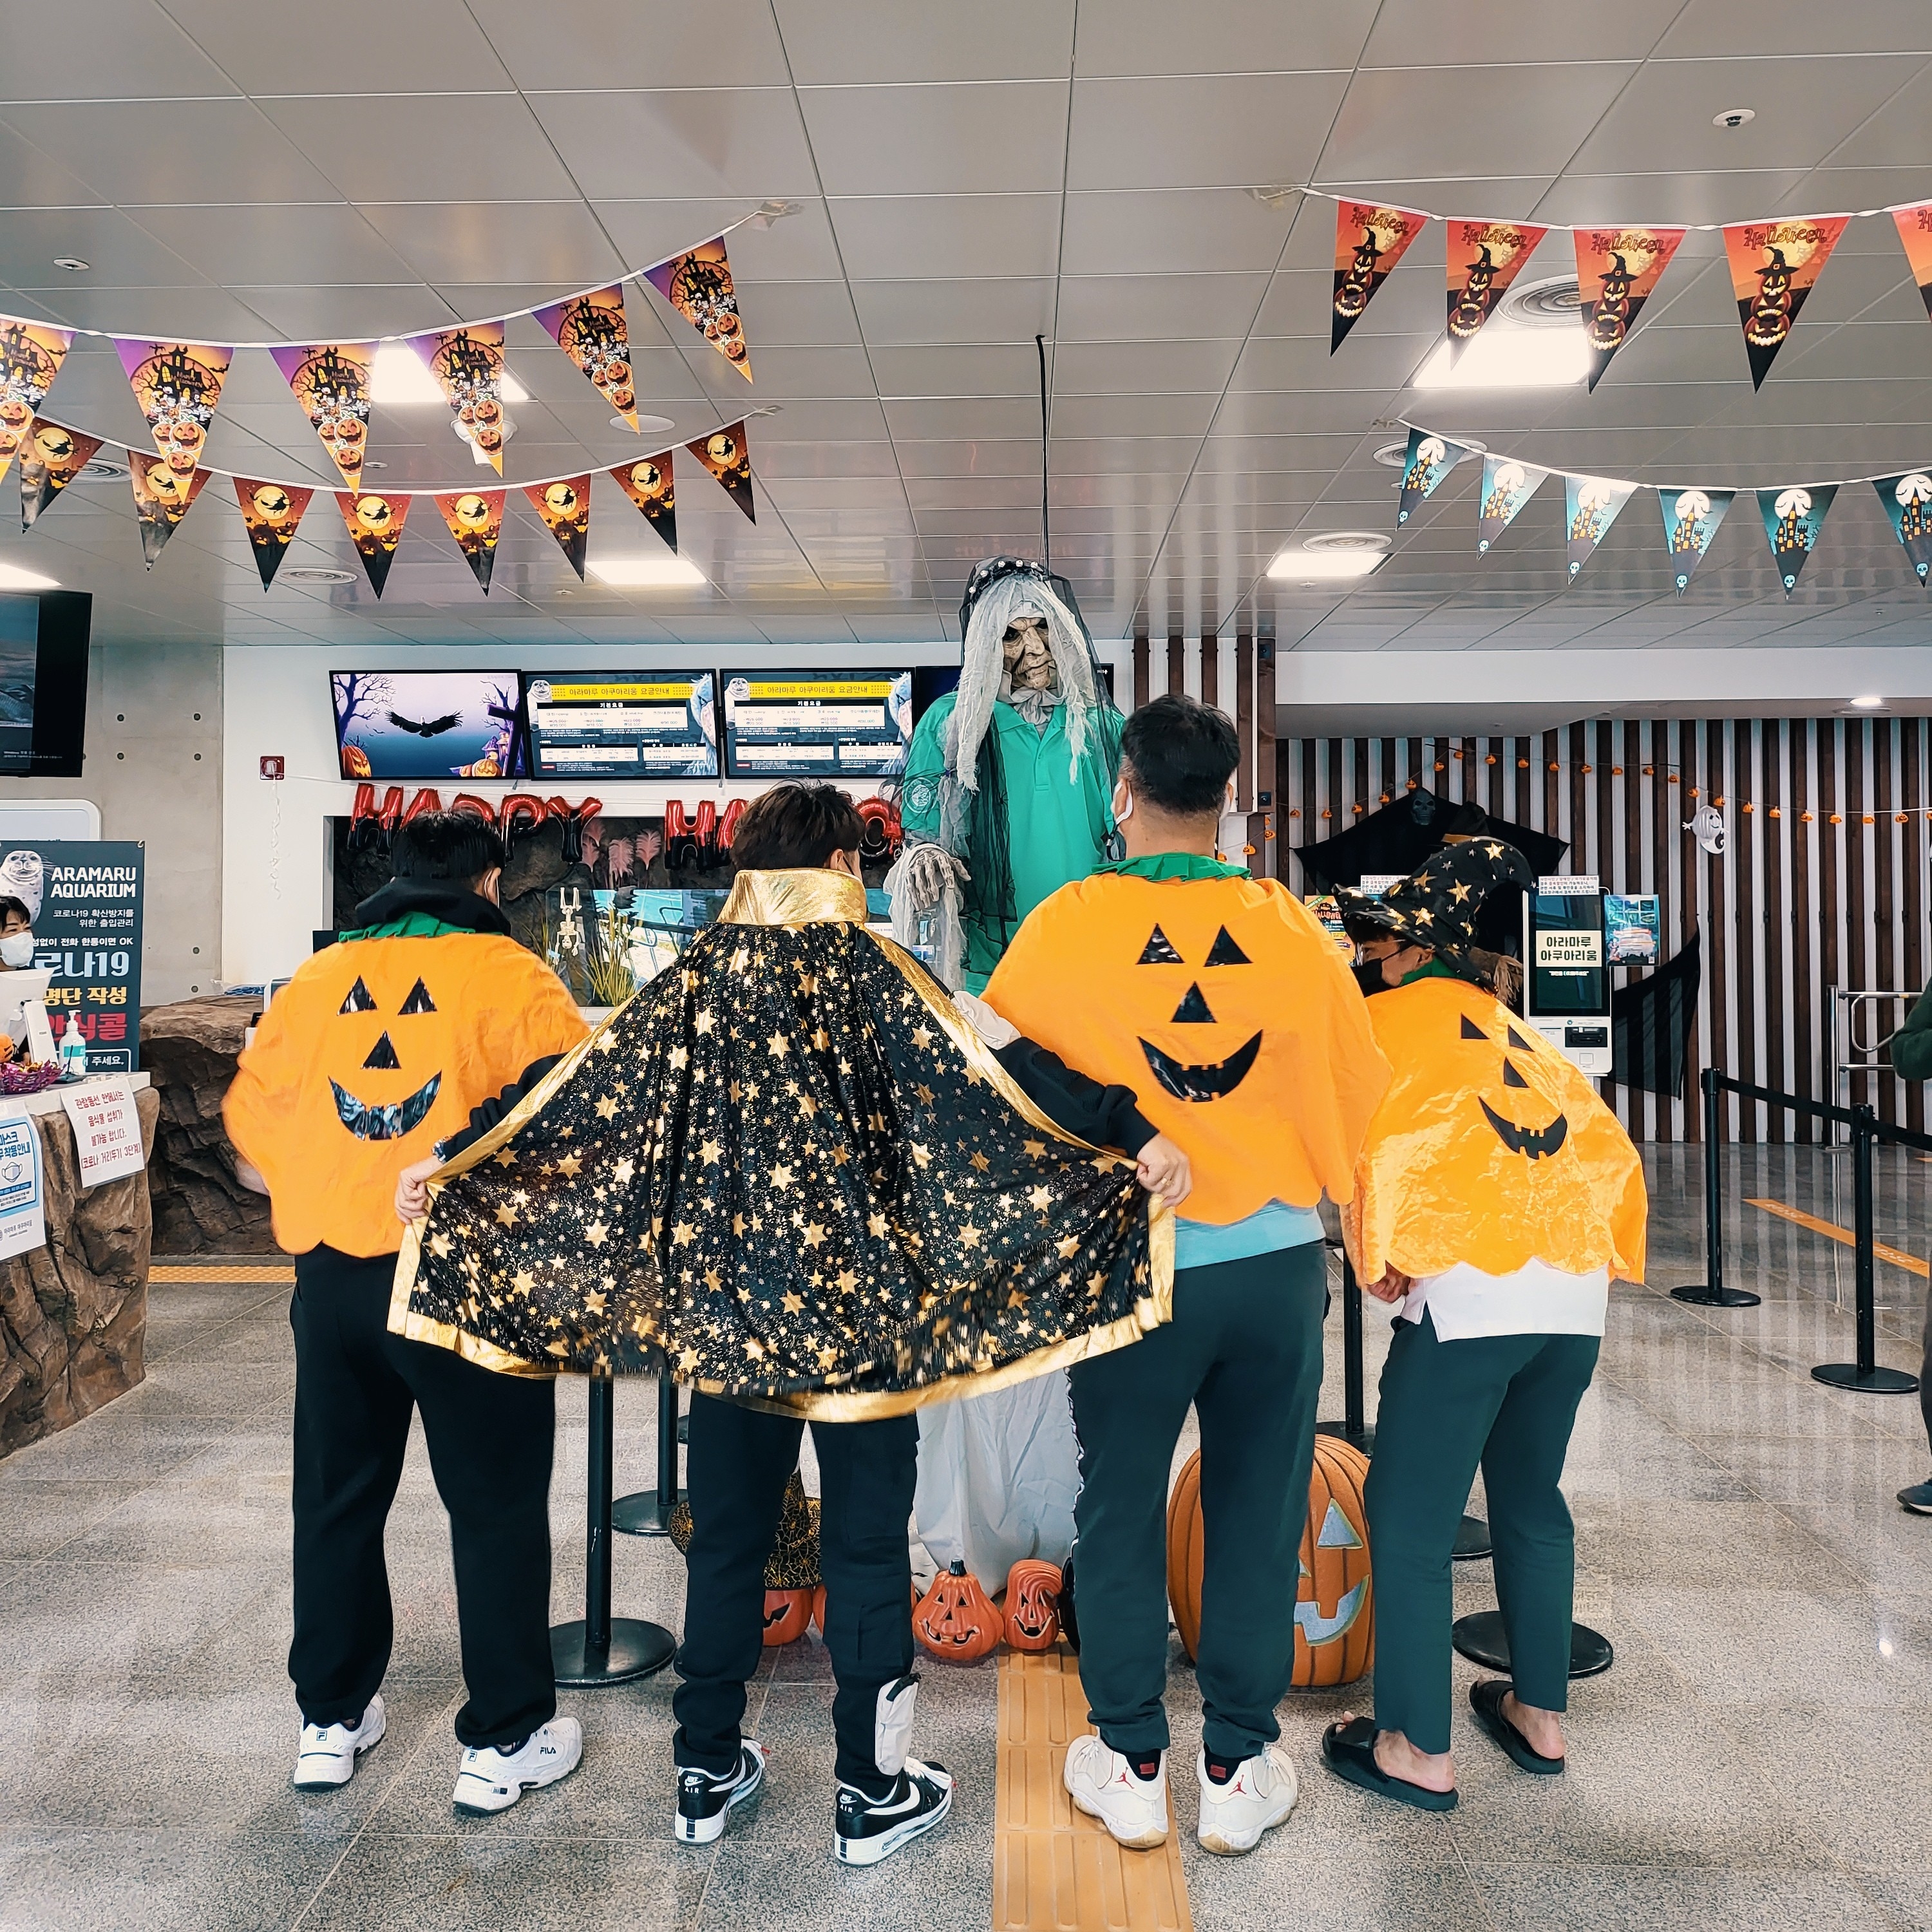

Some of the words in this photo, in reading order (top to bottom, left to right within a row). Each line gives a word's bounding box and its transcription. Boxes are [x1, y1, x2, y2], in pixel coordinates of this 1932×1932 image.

[1744, 225, 1827, 249] Halloween
[51, 867, 137, 882] ARAMARU
[50, 883, 136, 898] AQUARIUM
[53, 909, 89, 918] 코로나19
[91, 909, 135, 918] 확산방지를
[79, 919, 97, 928] 위한
[99, 918, 134, 928] 출입관리
[32, 938, 57, 947] 성없이
[61, 938, 79, 946] 전화
[81, 937, 117, 947] 한통이면
[119, 937, 134, 945] OK
[1546, 936, 1591, 947] 아라마루
[1540, 950, 1597, 961] 아쿠아리움
[33, 951, 131, 978] 로나19
[86, 986, 128, 1005] 작성
[91, 1056, 124, 1067] 주세요.
[75, 1094, 101, 1110] 관람동선
[88, 1113, 105, 1127] 음식물
[106, 1108, 124, 1123] 섭취가
[91, 1133, 107, 1147] 불가능
[108, 1127, 127, 1142] 합니다.
[100, 1147, 122, 1164] 거리두기
[540, 1746, 556, 1755] FILA
[839, 1804, 853, 1814] AIR
